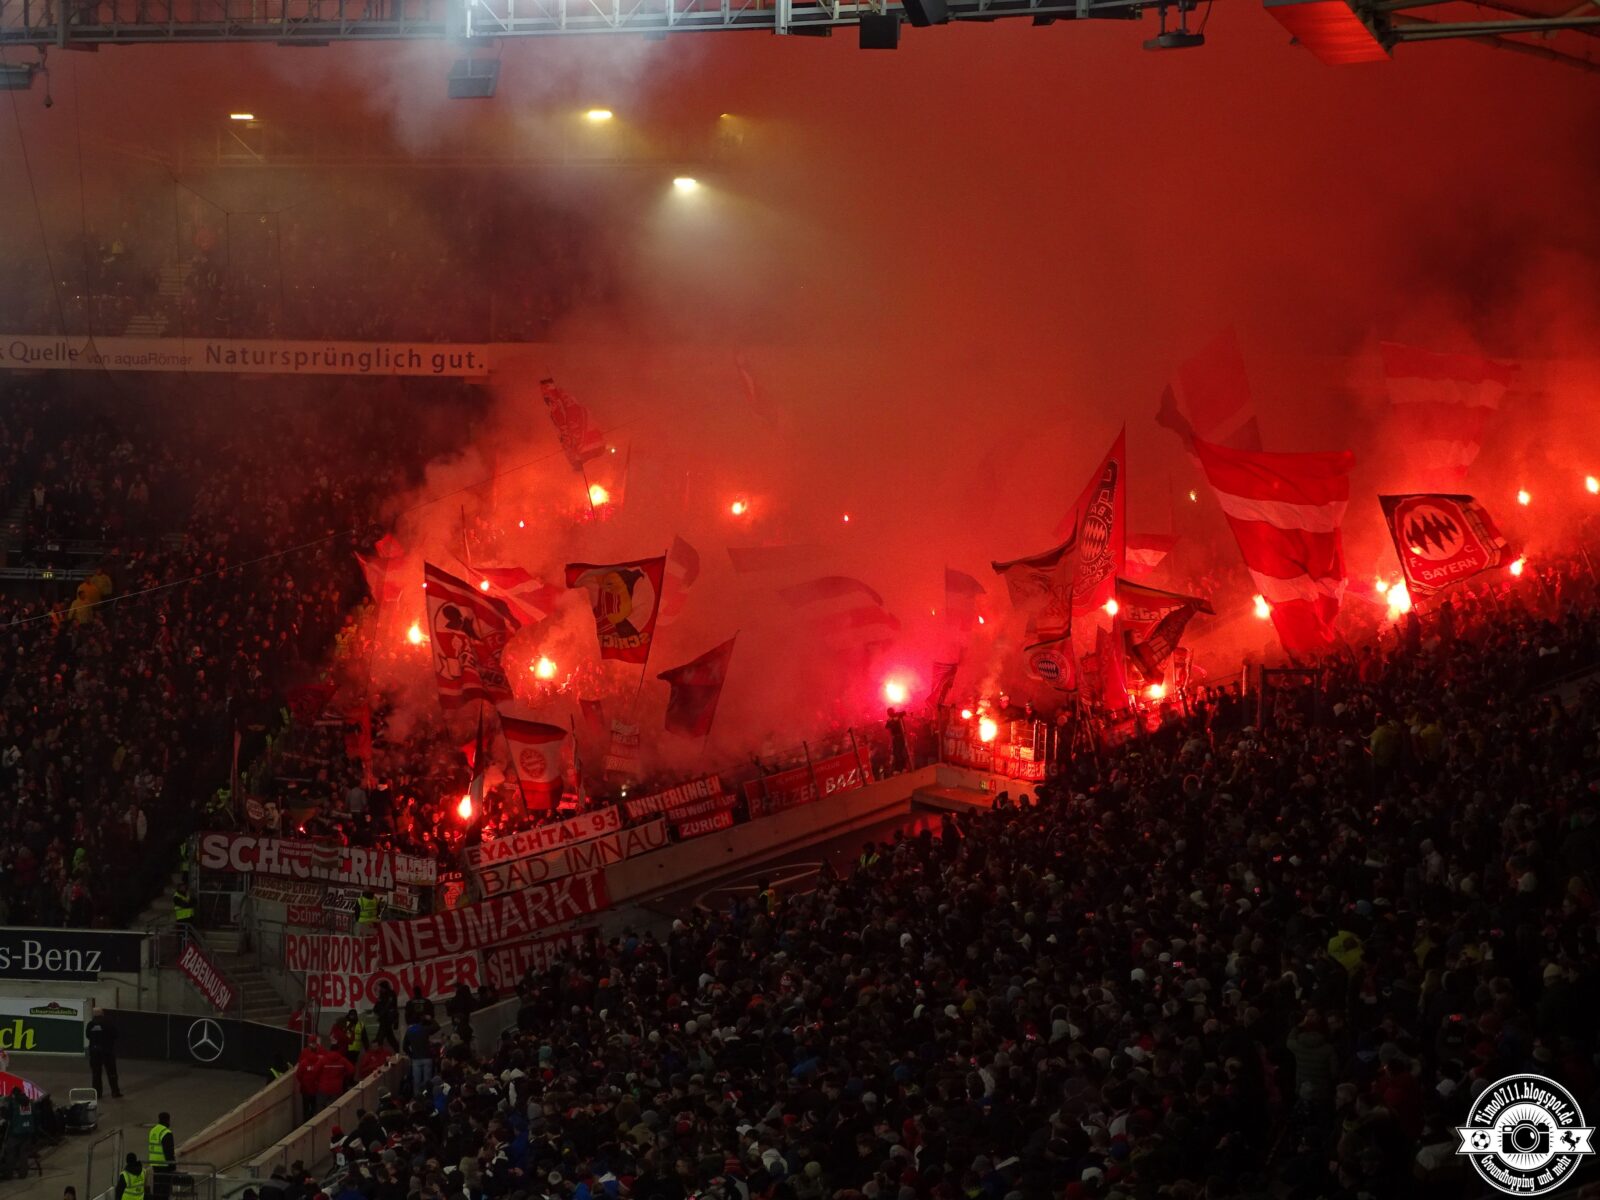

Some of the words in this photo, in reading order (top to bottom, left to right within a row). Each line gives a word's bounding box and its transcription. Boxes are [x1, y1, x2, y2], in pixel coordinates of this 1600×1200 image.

[9, 341, 79, 363] Quelle
[87, 354, 109, 365] von
[206, 344, 421, 372] Natursprünglich
[431, 347, 485, 373] gut.
[1421, 557, 1478, 580] BAYERN
[624, 776, 721, 819] WINTERLINGEN
[467, 824, 586, 866] EYACHTAL
[592, 810, 618, 832] 93
[480, 857, 549, 895] BAD
[564, 820, 666, 872] IMNAU
[381, 869, 599, 963] NEUMARKT
[287, 935, 378, 974] ROHRDORF
